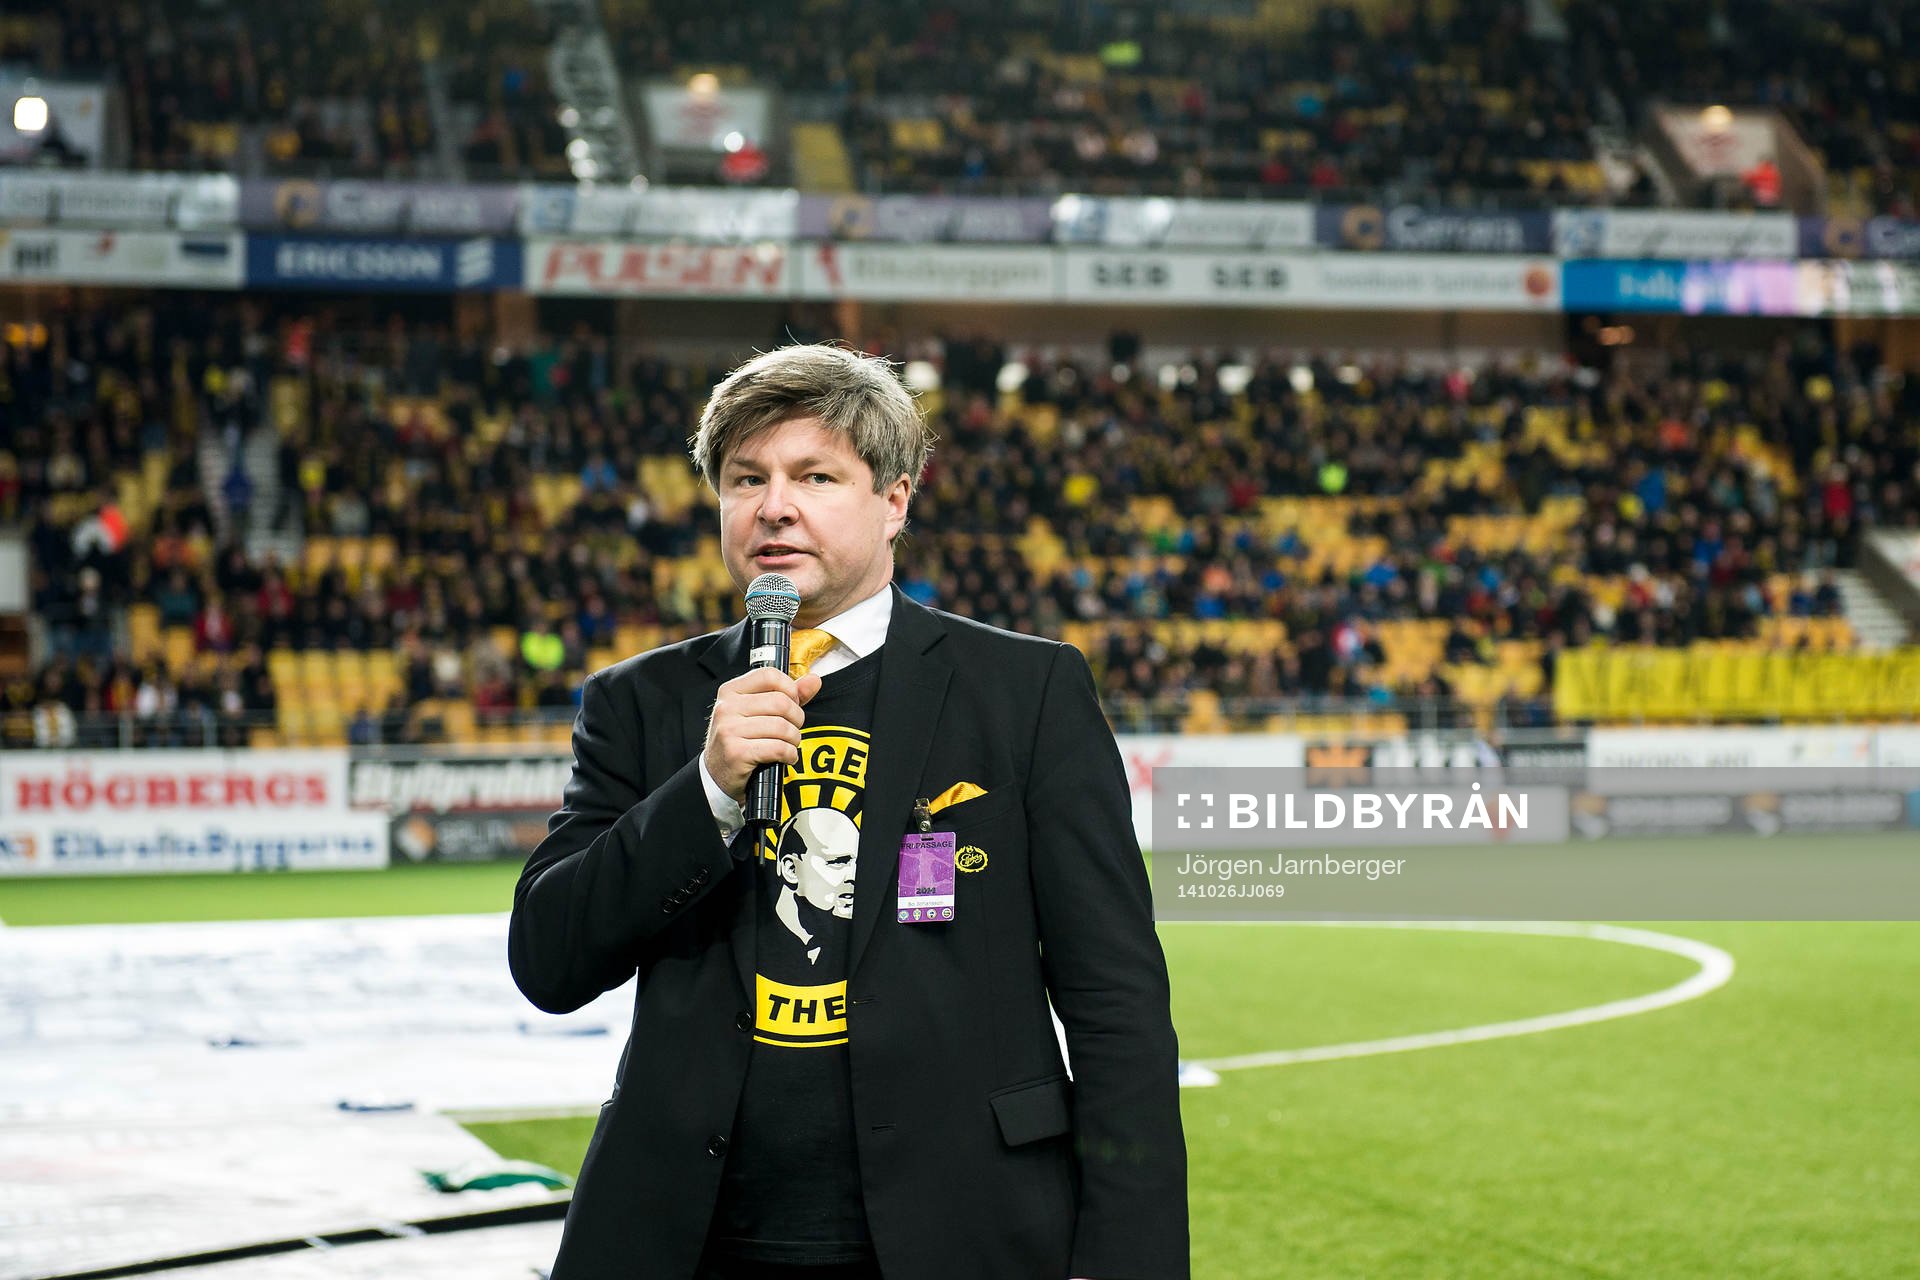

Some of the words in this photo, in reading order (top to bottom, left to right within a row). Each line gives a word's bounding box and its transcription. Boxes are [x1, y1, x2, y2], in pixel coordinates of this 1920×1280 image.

[276, 241, 442, 279] ERICSSON
[541, 243, 787, 291] PULSEN
[15, 761, 328, 811] HÖGBERGS
[915, 840, 953, 849] PASSAGE
[768, 994, 846, 1024] THE
